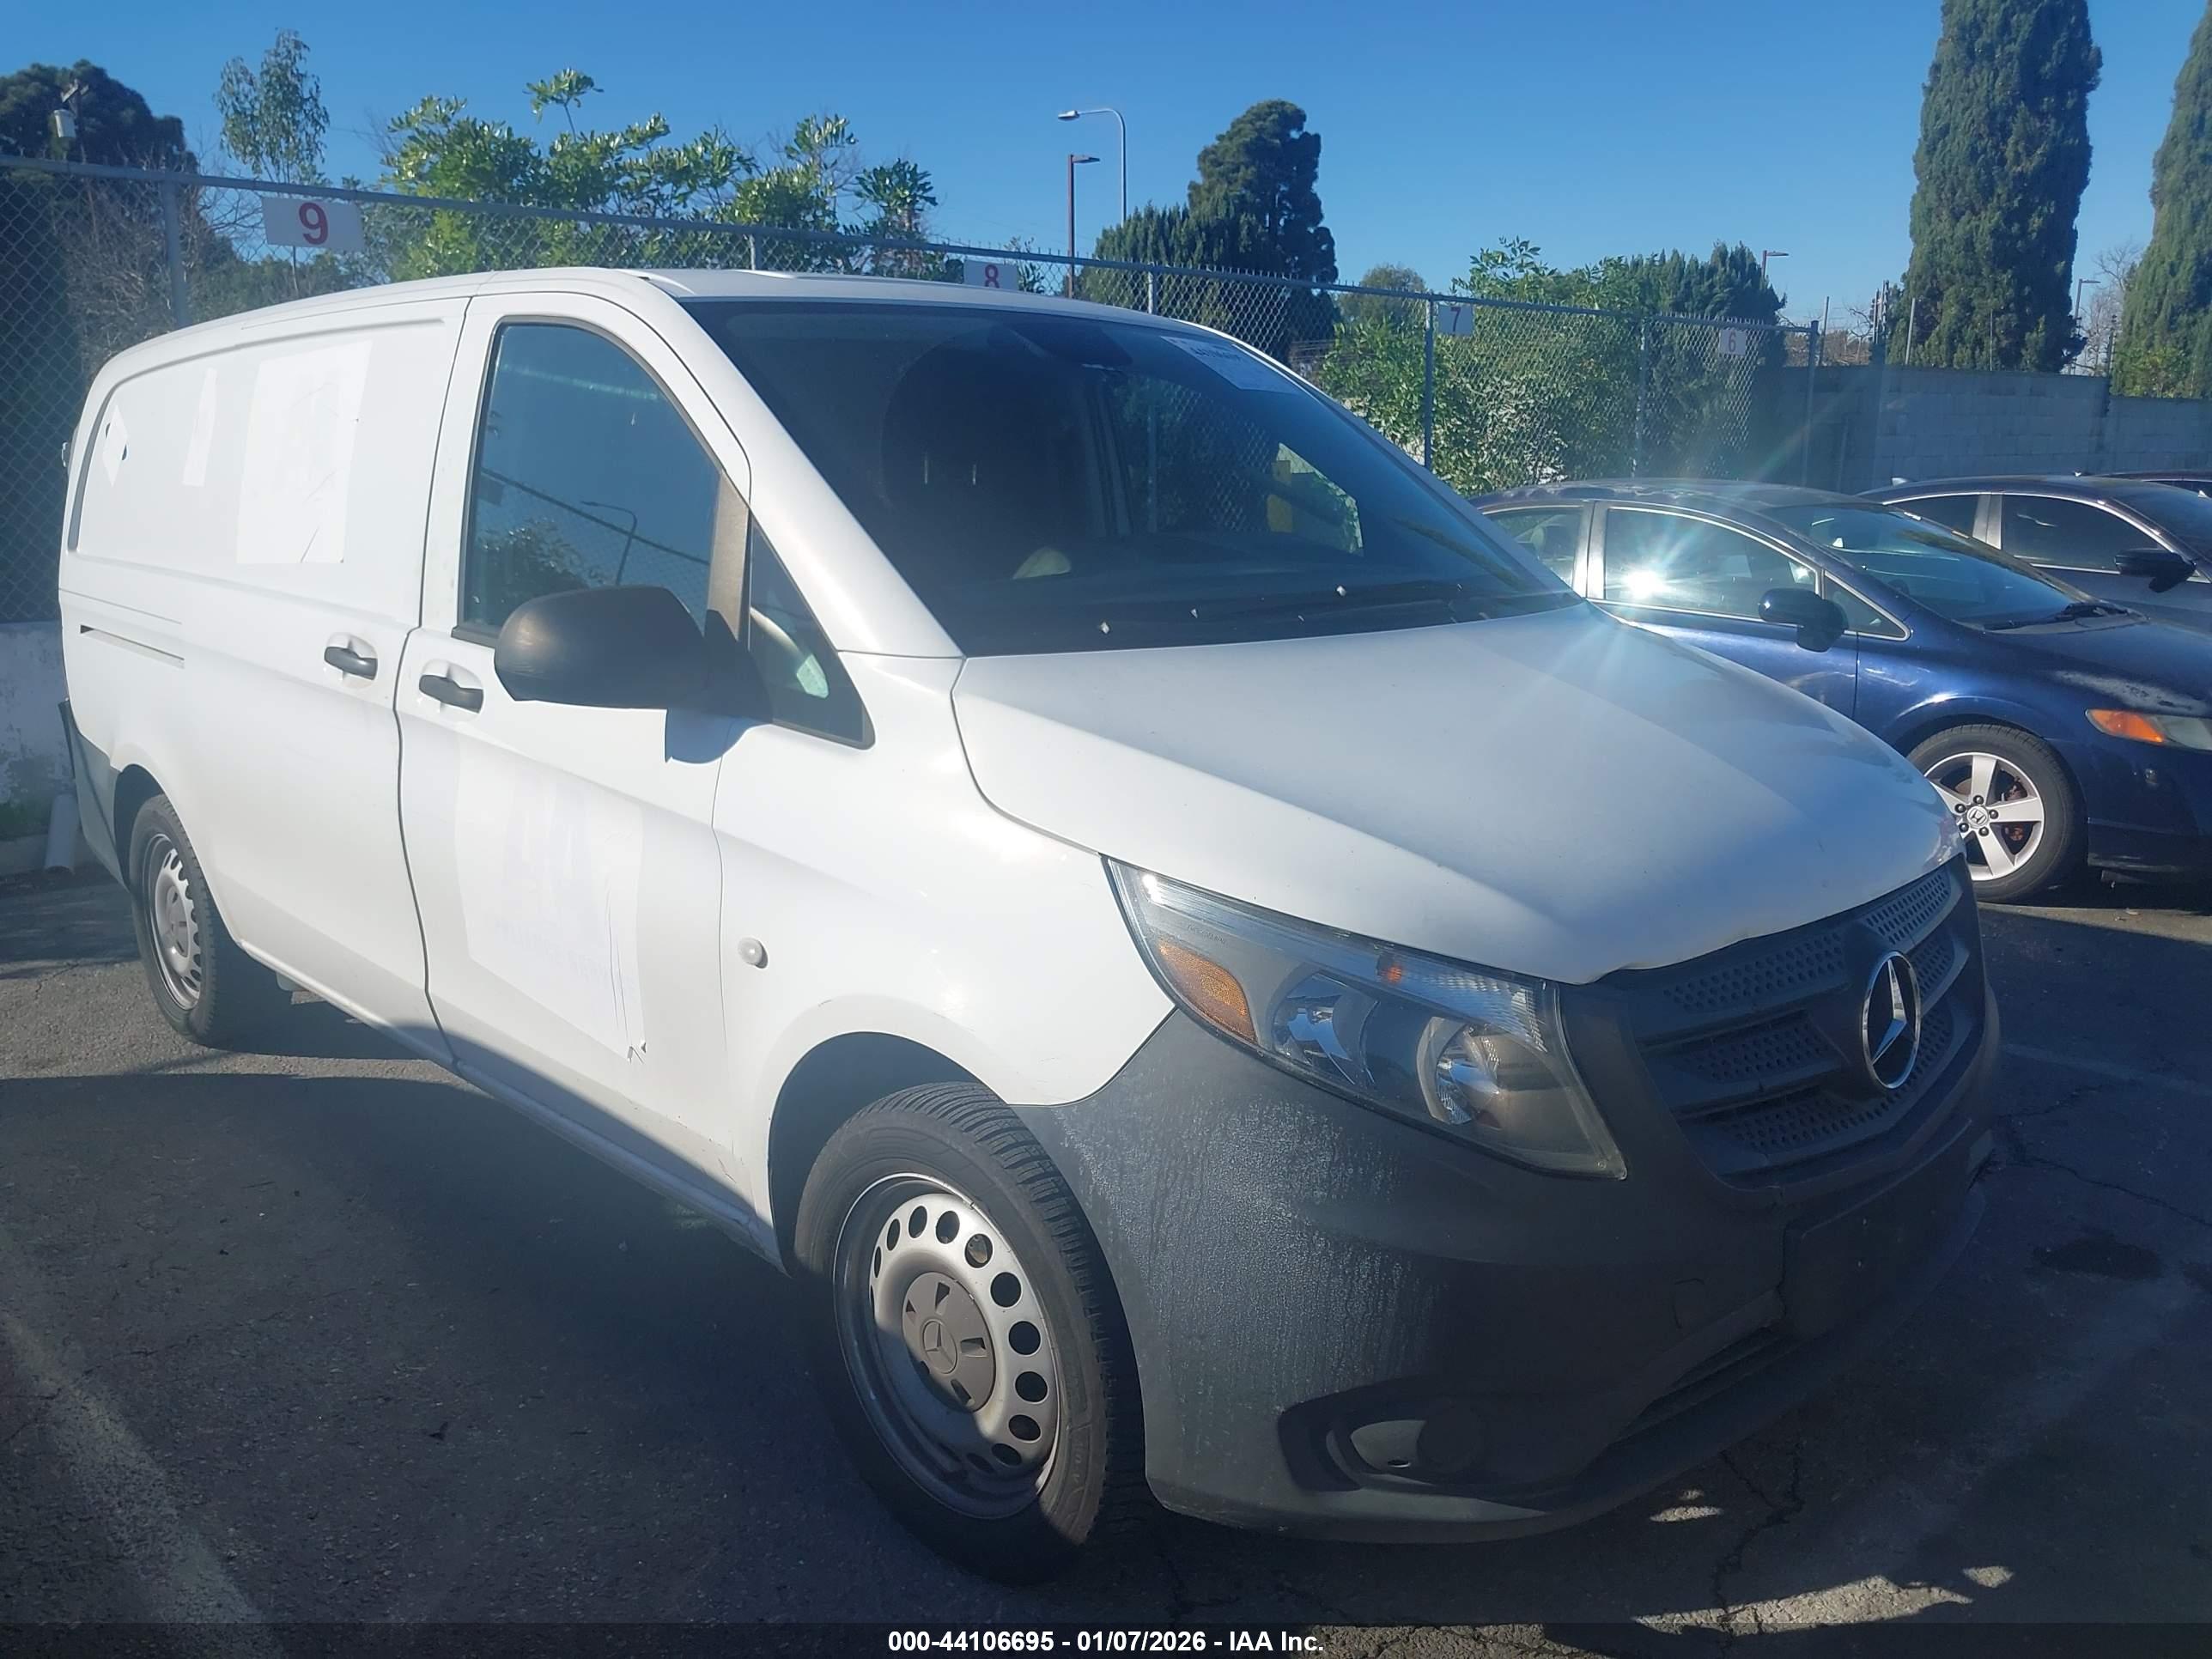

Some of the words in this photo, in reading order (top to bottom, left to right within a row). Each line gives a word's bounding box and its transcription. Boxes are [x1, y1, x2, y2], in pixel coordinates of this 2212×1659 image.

[299, 203, 328, 245] 9
[985, 264, 1000, 289] 8
[1450, 306, 1462, 332] 7
[1728, 331, 1736, 353] 6
